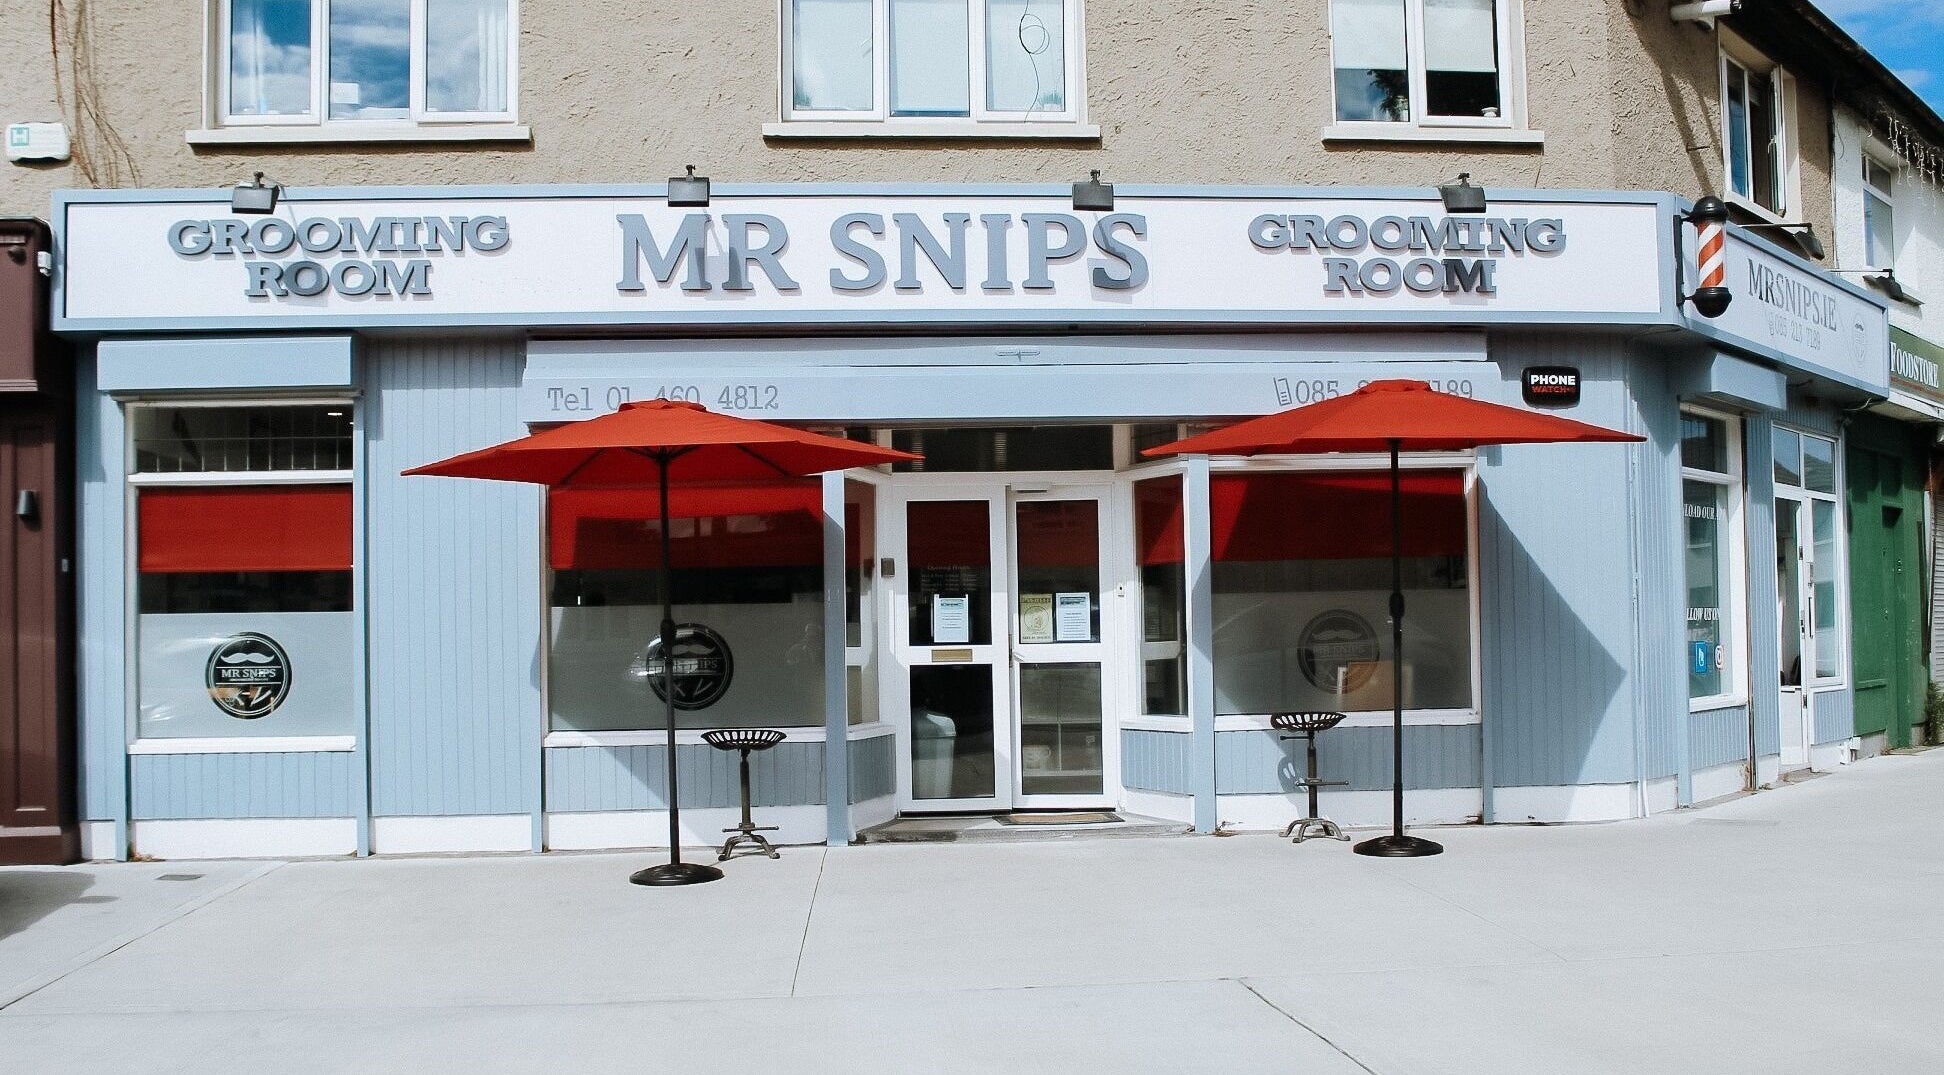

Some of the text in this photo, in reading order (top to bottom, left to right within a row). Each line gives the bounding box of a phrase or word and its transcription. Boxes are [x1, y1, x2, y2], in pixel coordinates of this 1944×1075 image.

[168, 216, 510, 255] GROOMING
[616, 212, 1150, 292] MR SNIPS
[1248, 214, 1567, 253] GROOMING
[244, 260, 432, 297] ROOM
[1322, 257, 1497, 293] ROOM
[1747, 257, 1837, 332] MRSNIPS.IE
[1530, 375, 1576, 385] PHONE
[1890, 341, 1939, 388] FOODSTORE
[547, 387, 593, 411] Tel
[717, 385, 779, 410] 4812
[221, 668, 276, 678] MR SNIPS
